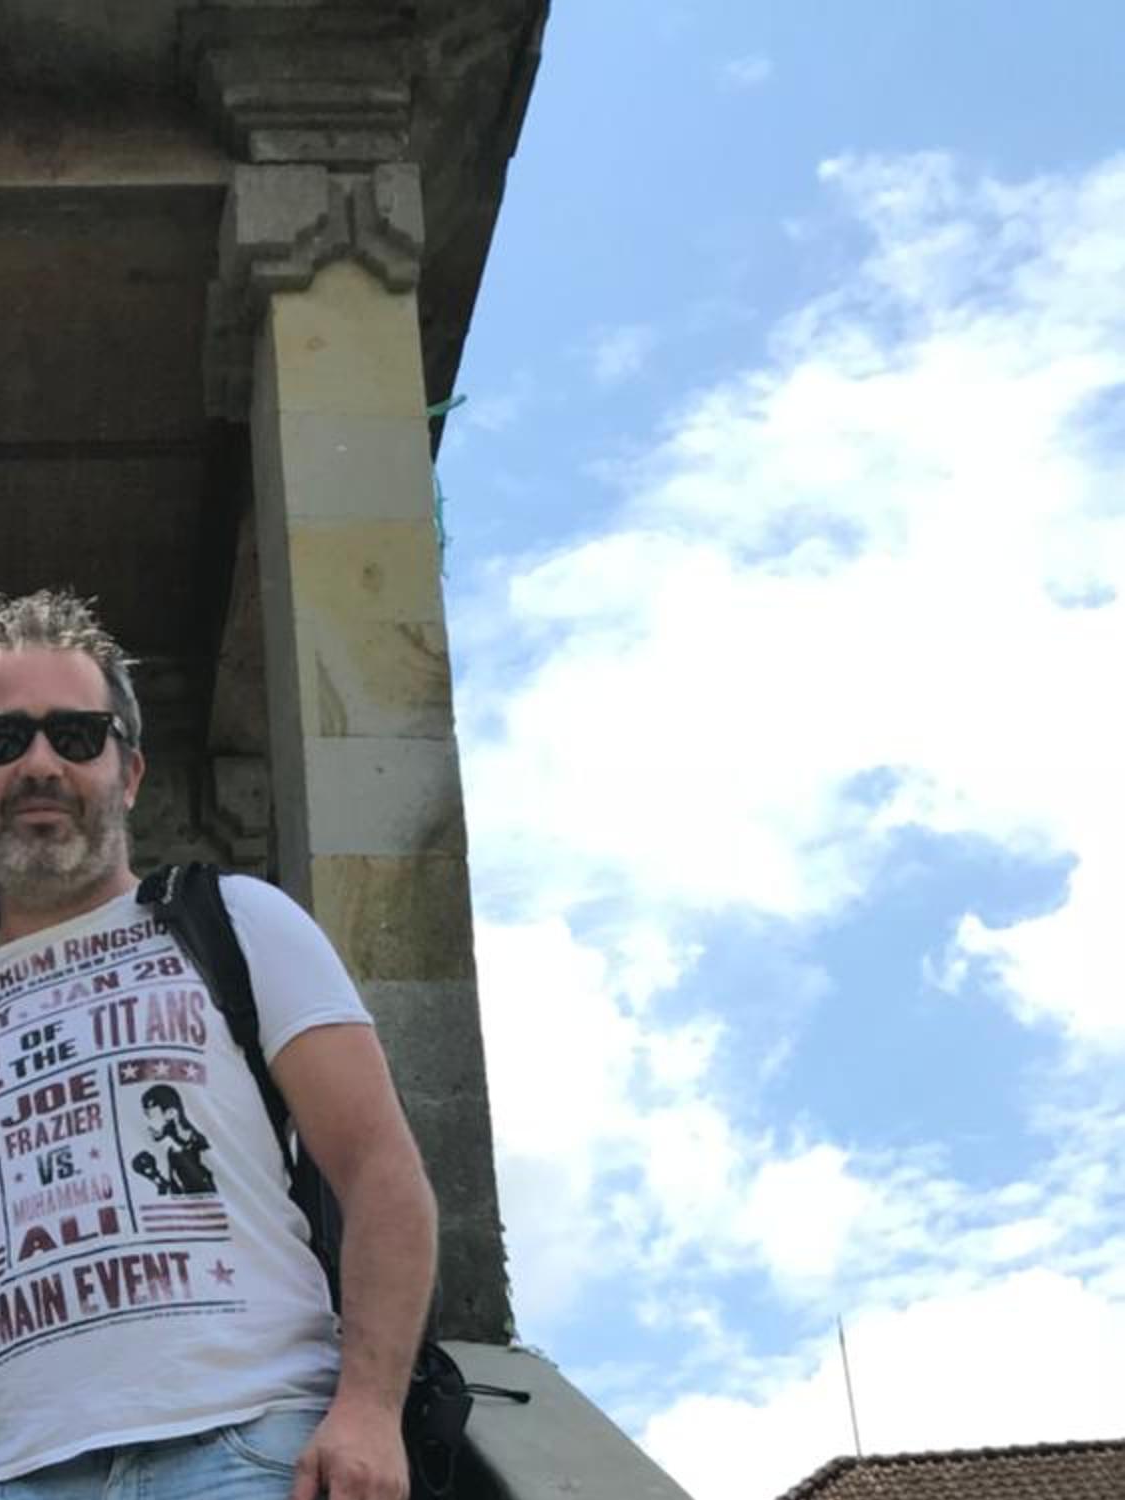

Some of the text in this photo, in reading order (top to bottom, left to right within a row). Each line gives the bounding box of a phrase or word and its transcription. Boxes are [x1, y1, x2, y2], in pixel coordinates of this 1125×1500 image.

[63, 917, 170, 966] RINGSID
[133, 955, 184, 982] 28
[20, 1019, 65, 1051] OF
[88, 989, 207, 1051] TITANS
[9, 1037, 78, 1079] THE
[0, 1069, 100, 1128] JOE
[4, 1103, 103, 1161] FRAZIER
[18, 1205, 120, 1262] ALI
[73, 1251, 193, 1315] EVENT
